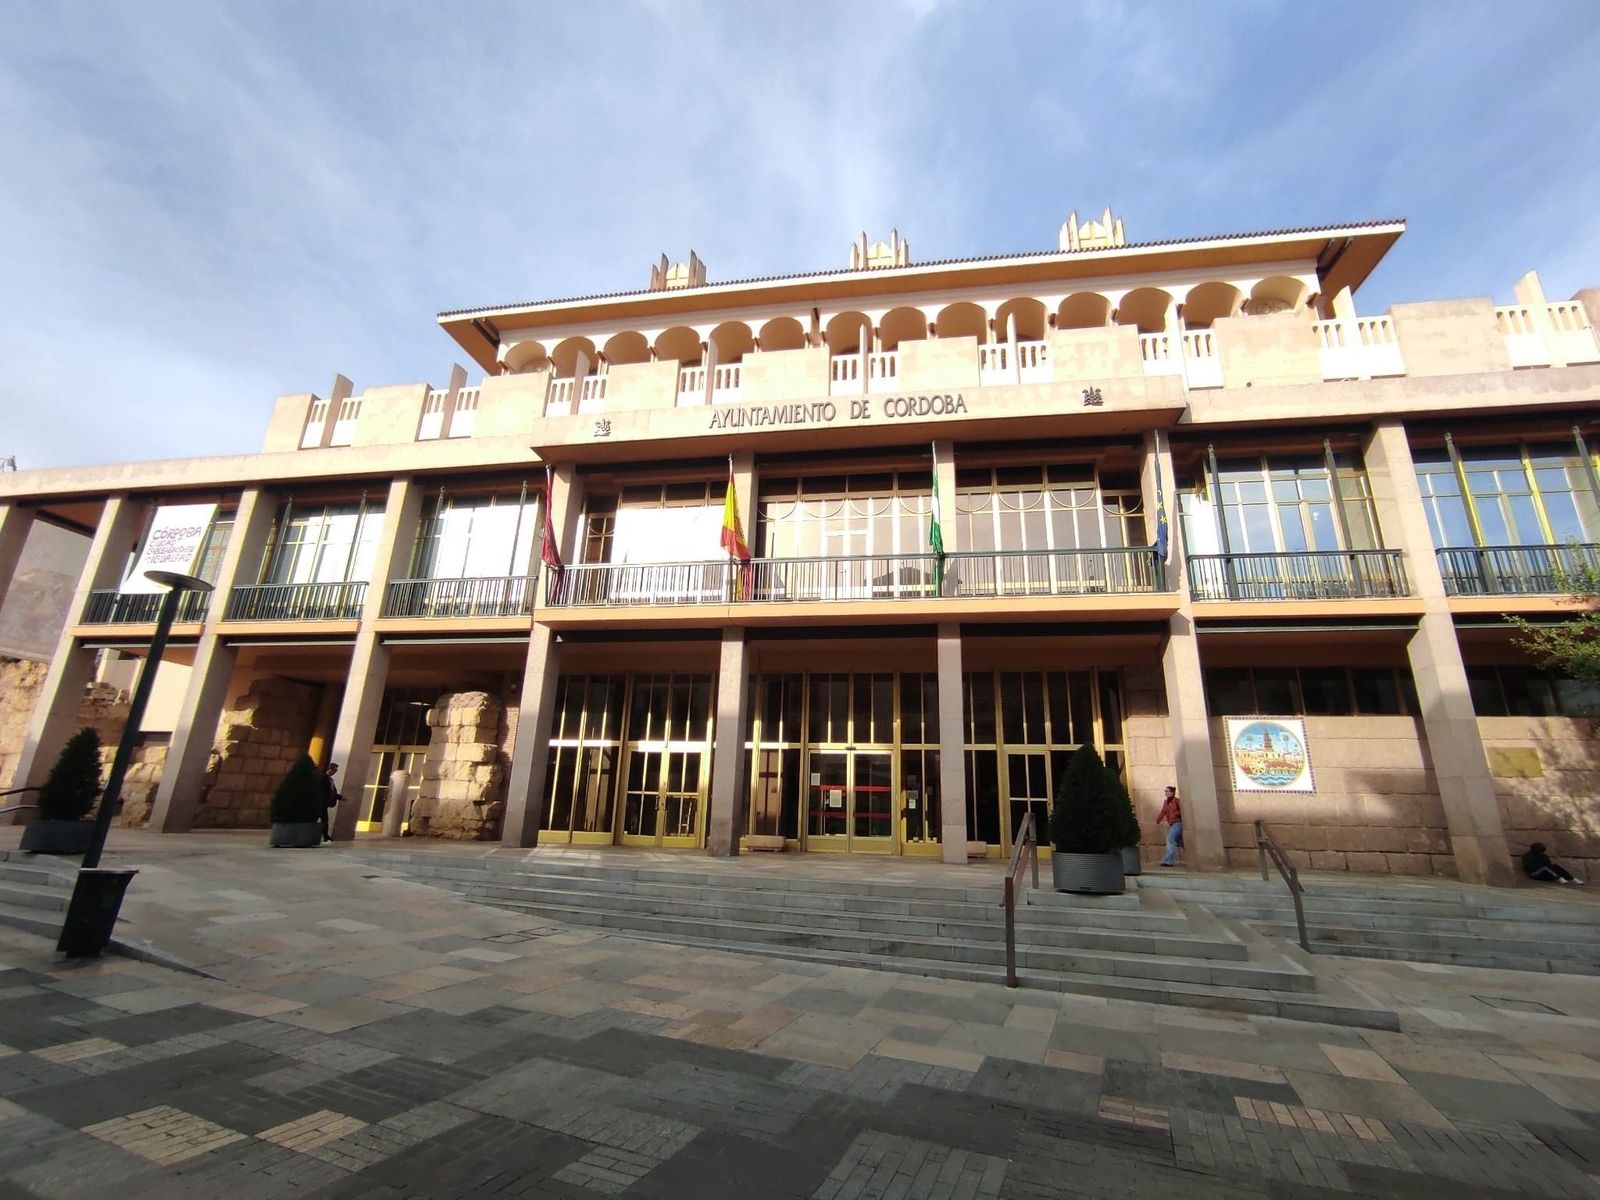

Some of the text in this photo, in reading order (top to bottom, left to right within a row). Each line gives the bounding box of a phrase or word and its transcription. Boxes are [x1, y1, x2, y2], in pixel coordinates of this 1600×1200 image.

[709, 394, 968, 429] AYUNTAMIENTO DE CORDOBA
